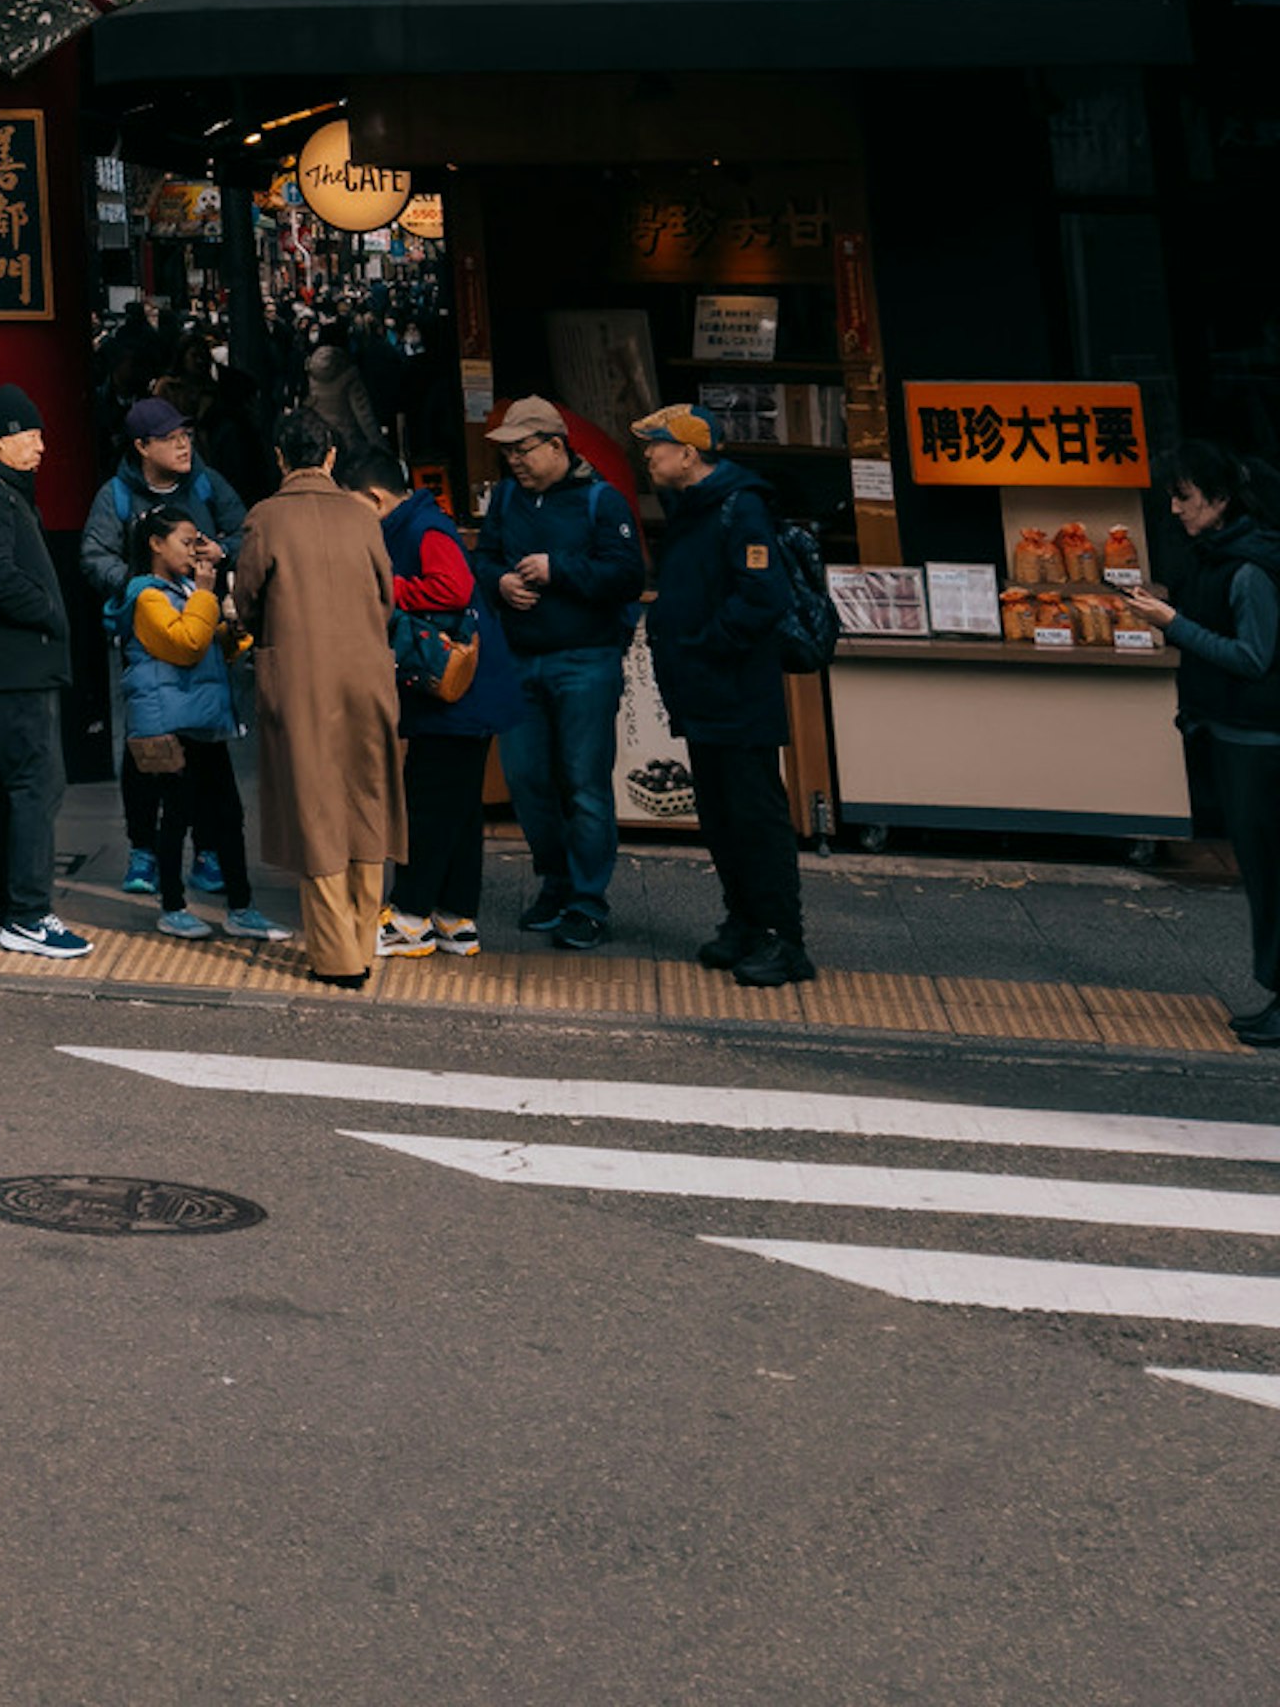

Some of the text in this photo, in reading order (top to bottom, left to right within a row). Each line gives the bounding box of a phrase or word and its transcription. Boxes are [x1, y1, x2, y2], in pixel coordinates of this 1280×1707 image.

[306, 160, 405, 193] The CAFE
[917, 405, 1140, 465] 聘珍大甘栗
